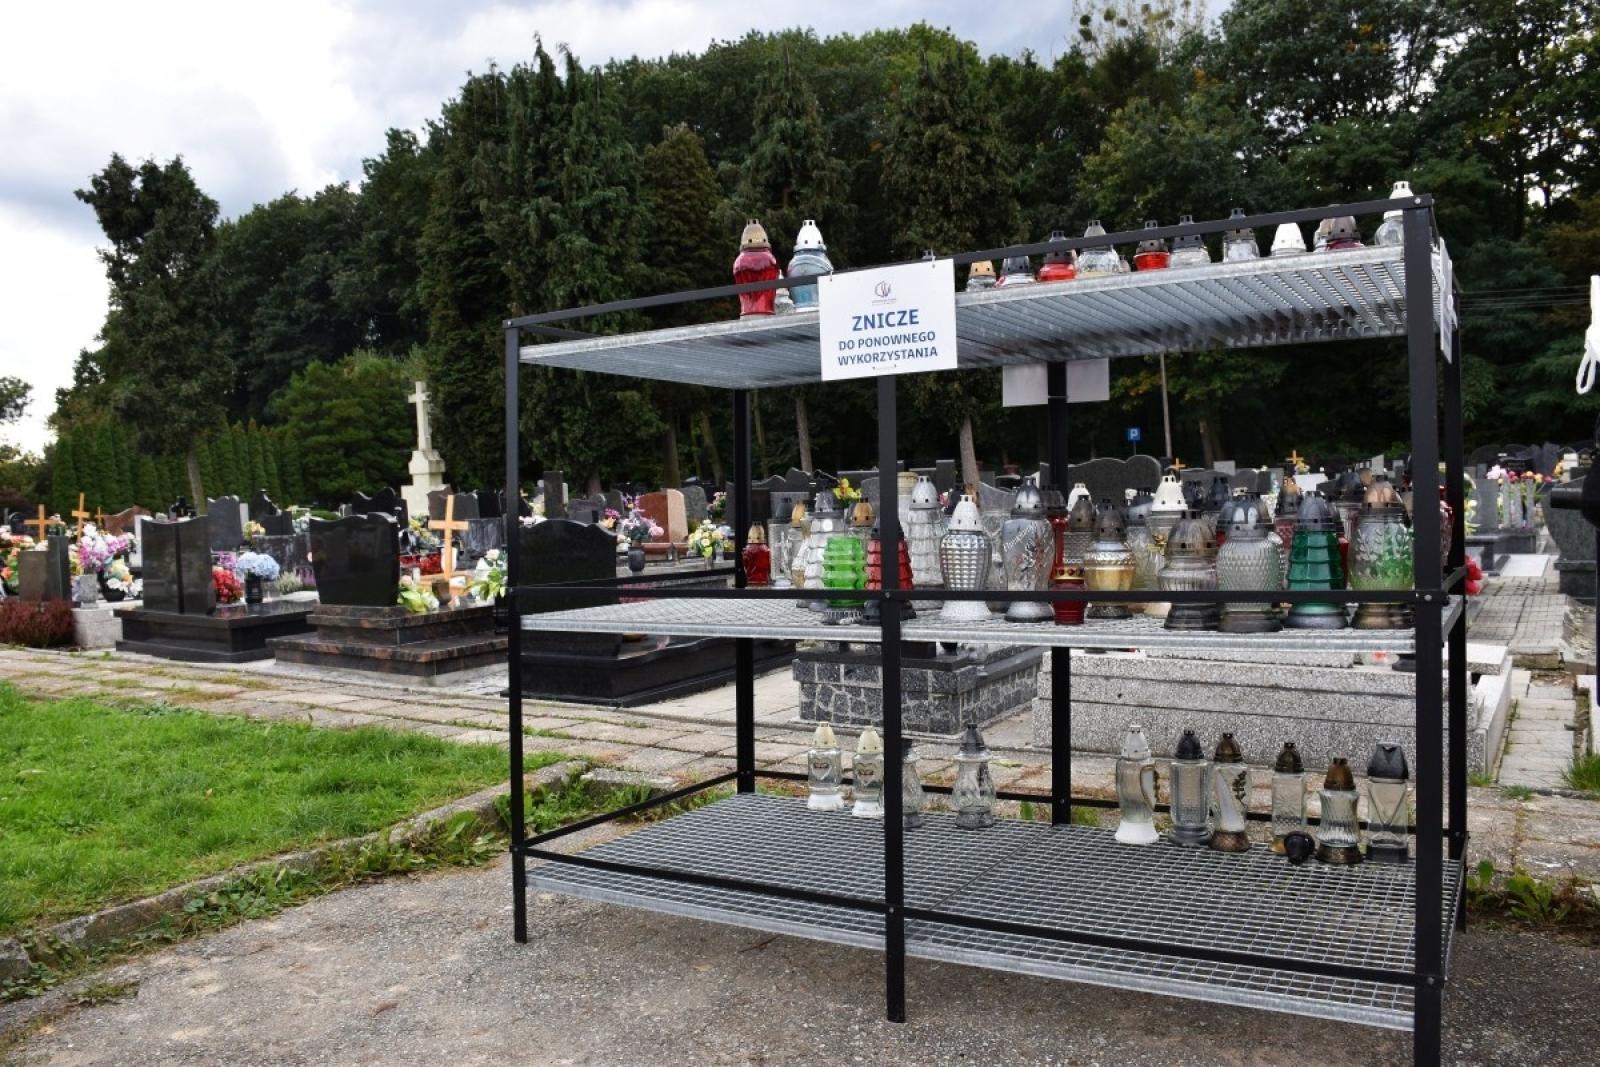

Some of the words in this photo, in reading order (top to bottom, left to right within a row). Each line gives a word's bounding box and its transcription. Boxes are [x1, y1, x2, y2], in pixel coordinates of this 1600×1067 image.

[852, 309, 920, 332] ZNICZE
[838, 339, 855, 351] DO
[858, 331, 936, 349] PONOWNEGO
[838, 346, 938, 366] WYKORZYSTANIA
[1130, 428, 1138, 440] P
